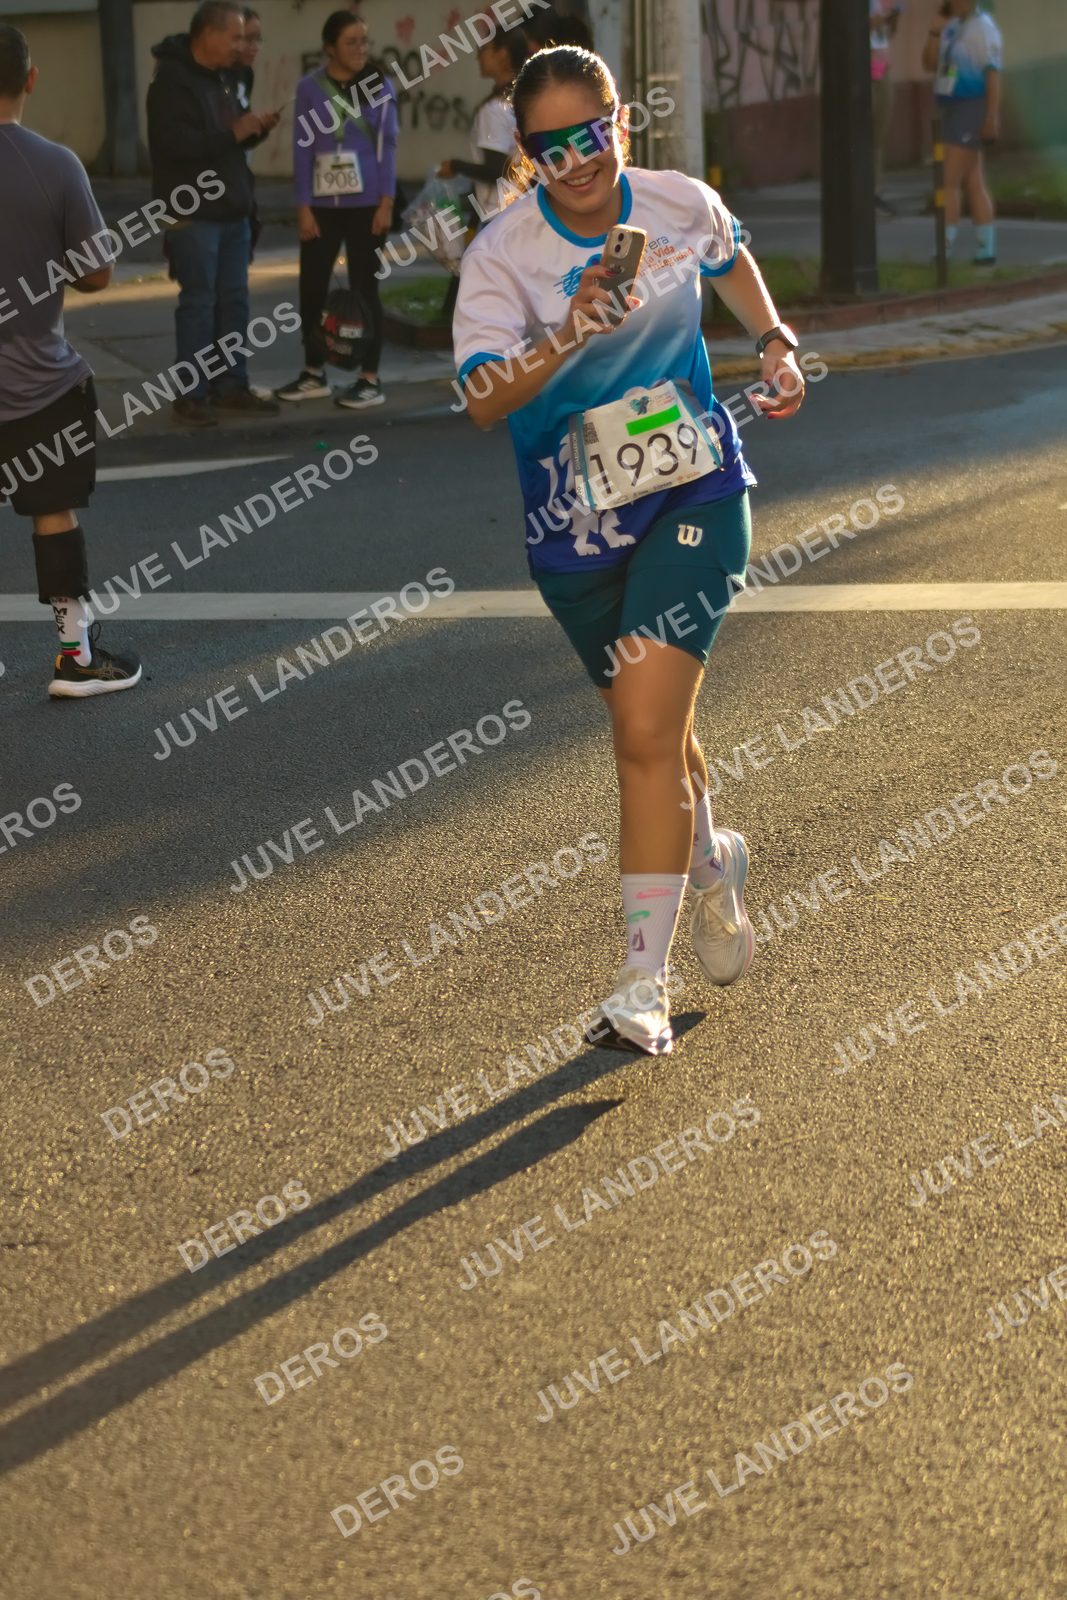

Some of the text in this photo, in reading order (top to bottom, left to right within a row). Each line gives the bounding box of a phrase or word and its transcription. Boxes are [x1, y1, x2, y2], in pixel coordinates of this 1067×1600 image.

[316, 171, 359, 191] 1908
[653, 244, 675, 258] Vida
[589, 423, 698, 495] 1939
